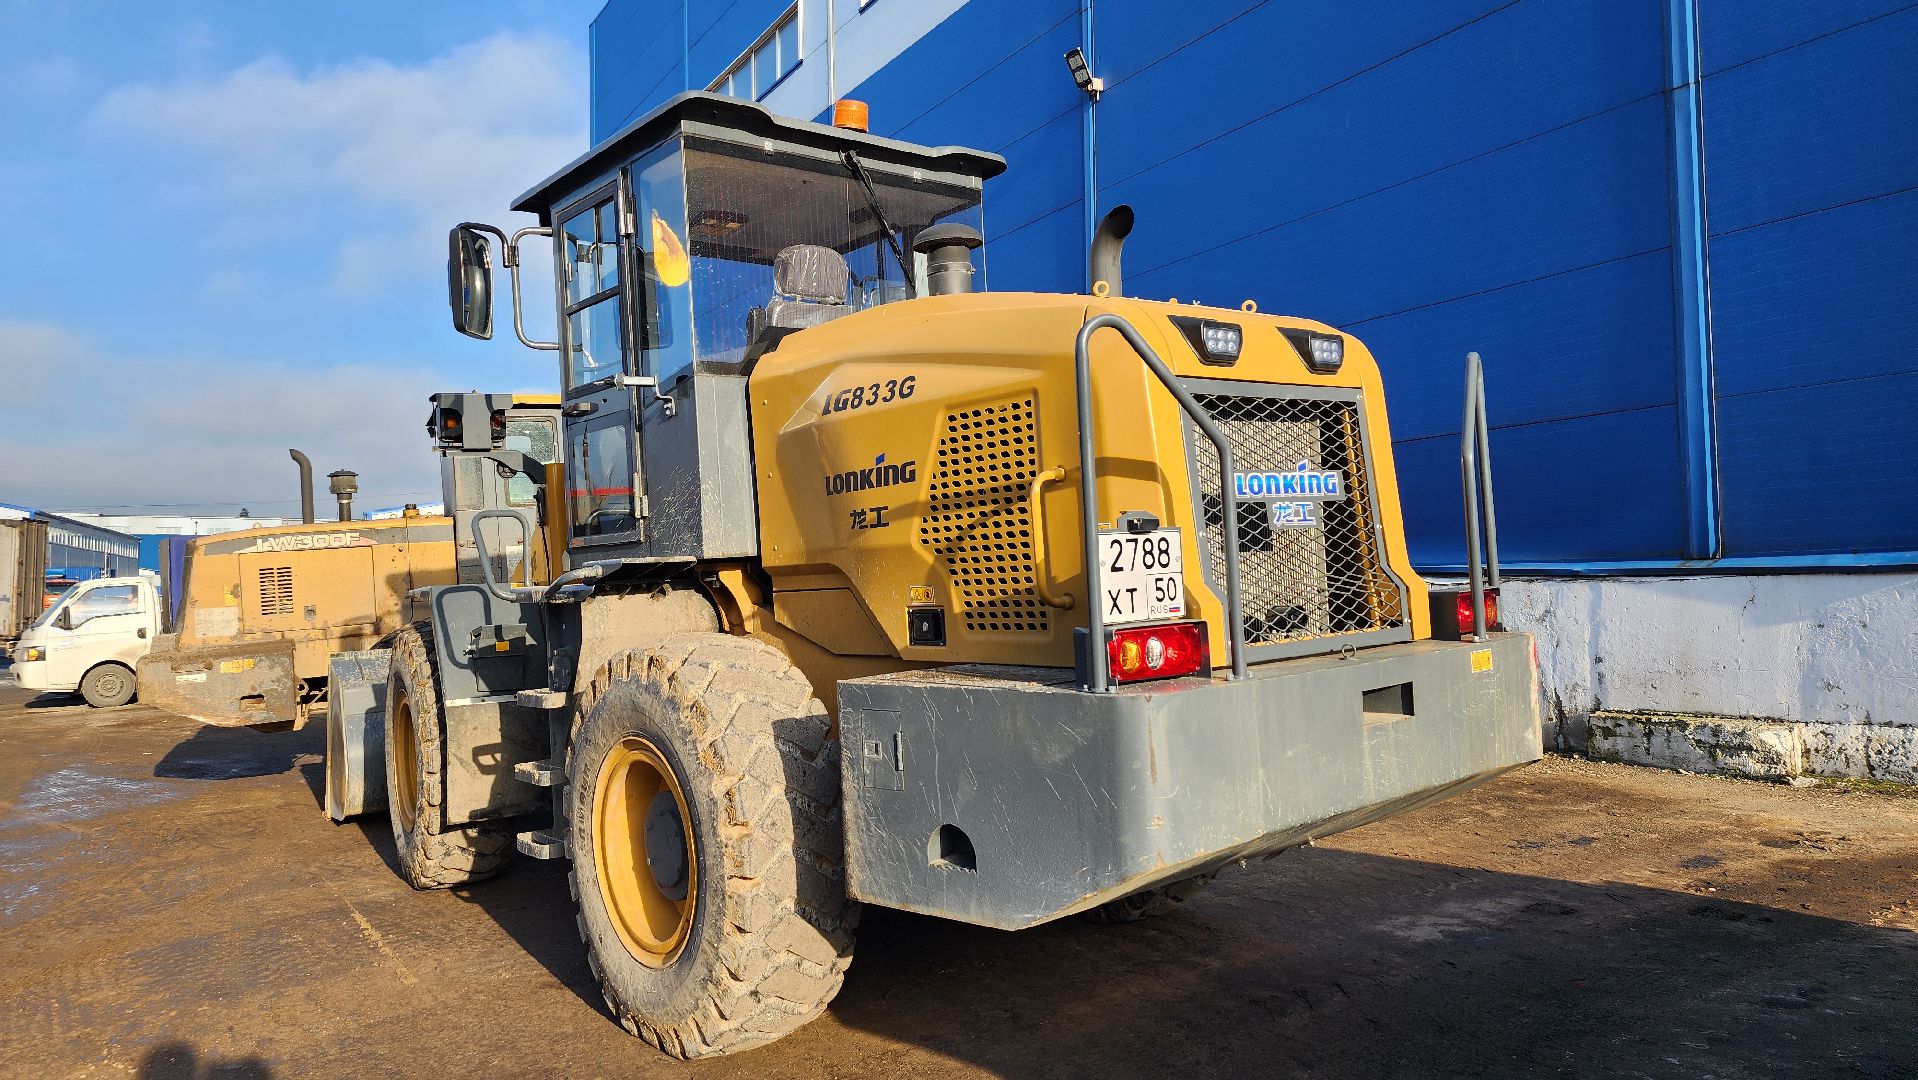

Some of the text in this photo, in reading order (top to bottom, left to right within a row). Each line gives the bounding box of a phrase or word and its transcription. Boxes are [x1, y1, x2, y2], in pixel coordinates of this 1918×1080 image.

[822, 376, 916, 416] LG833G
[825, 453, 916, 496] LONKING
[1235, 460, 1339, 497] LONKING
[850, 505, 889, 529] 龙工
[1273, 502, 1315, 525] 龙工
[256, 532, 360, 552] LW300F
[1109, 536, 1170, 573] 2788
[1154, 576, 1177, 602] 50
[1150, 603, 1169, 615] RUS
